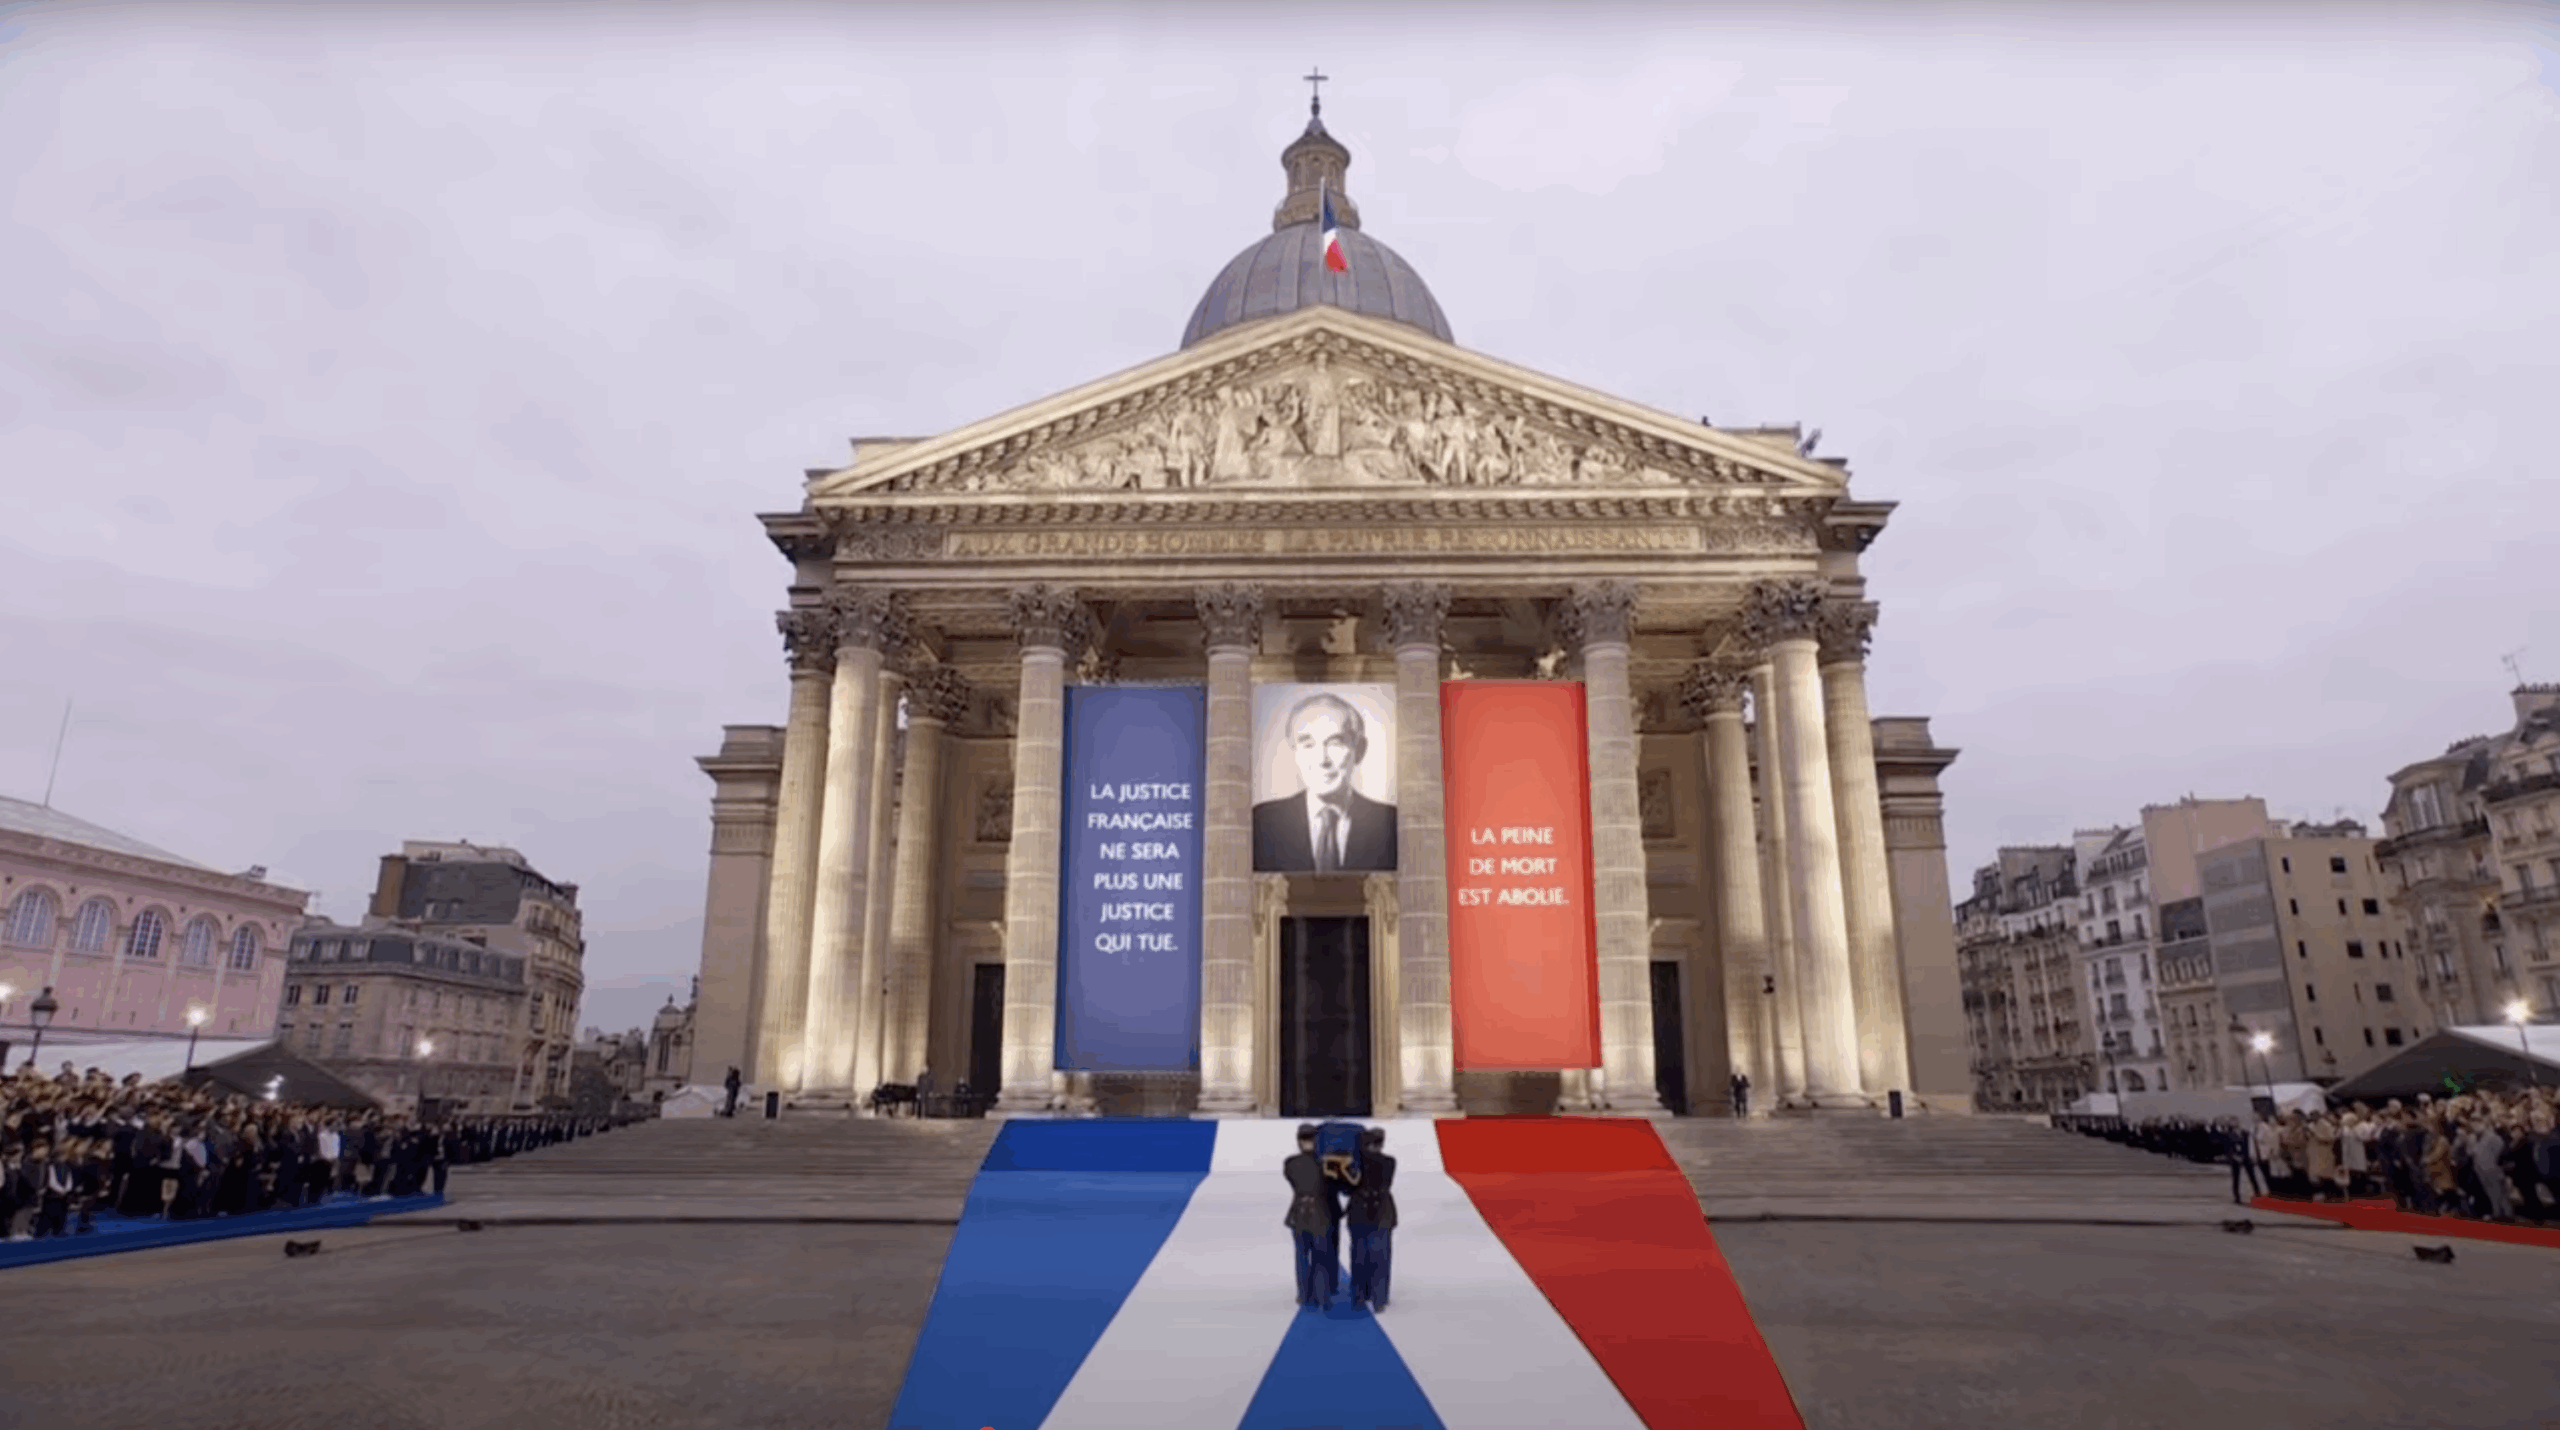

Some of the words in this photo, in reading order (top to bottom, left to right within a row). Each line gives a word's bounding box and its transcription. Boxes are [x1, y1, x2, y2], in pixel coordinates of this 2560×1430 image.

[1090, 783, 1115, 800] LA
[1118, 783, 1191, 803] JUSTICE
[1088, 813, 1193, 831] FRANÇAISE
[1471, 827, 1497, 845] LA
[1501, 826, 1554, 845] PEINE
[1100, 843, 1126, 859] NE
[1131, 843, 1180, 860] SERA
[1469, 857, 1496, 875] DE
[1501, 857, 1558, 875] MORT
[1094, 873, 1138, 889] PLUS
[1143, 873, 1183, 889] UNE
[1458, 887, 1492, 905] EST
[1497, 886, 1570, 905] ABOLIE.
[1101, 903, 1174, 921] JUSTICE
[1095, 933, 1131, 953] QUI
[1138, 933, 1179, 951] TUE.
